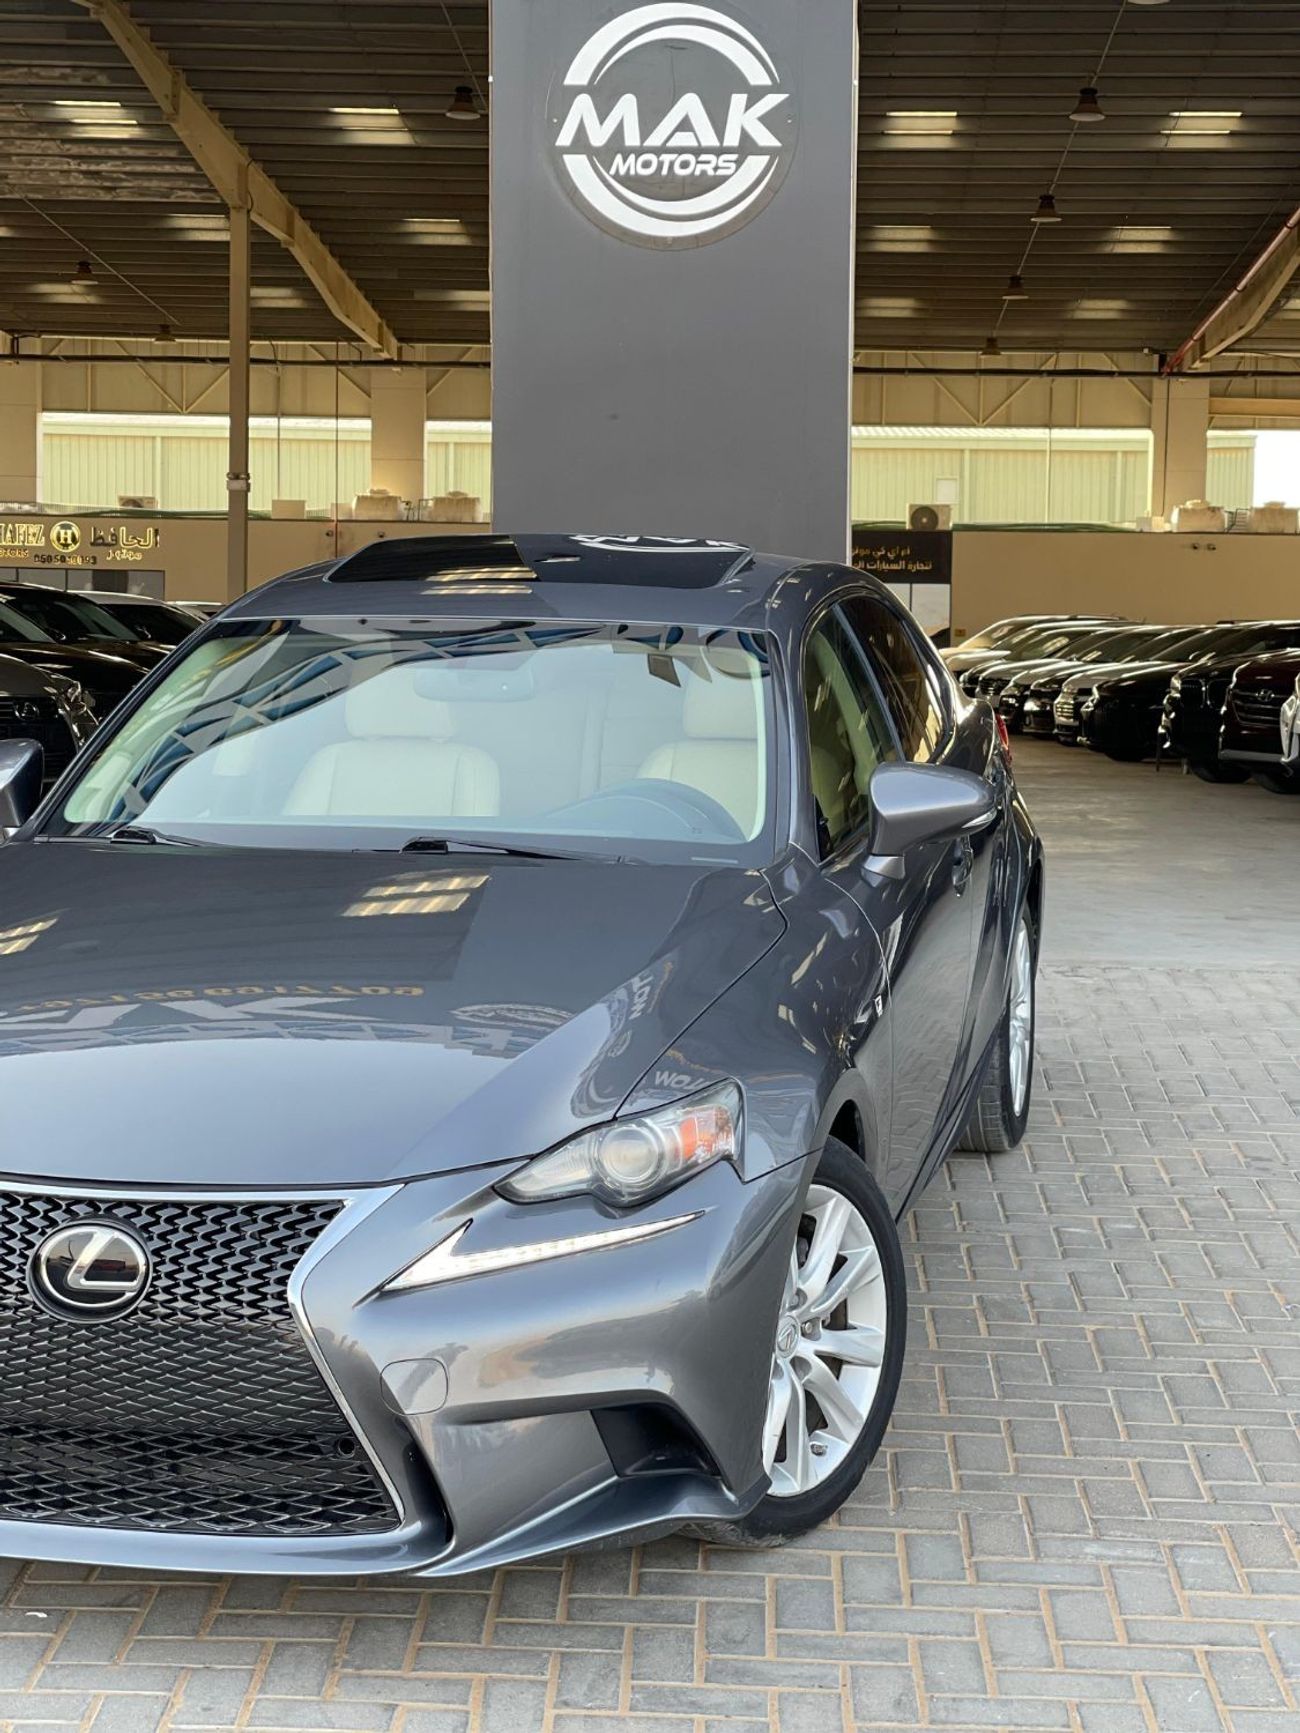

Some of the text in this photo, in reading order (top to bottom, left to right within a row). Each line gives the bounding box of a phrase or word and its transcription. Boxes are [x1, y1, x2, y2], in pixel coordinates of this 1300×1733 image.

[555, 92, 790, 147] MAK
[608, 153, 739, 176] MOTORS
[90, 526, 160, 549] الحافظ
